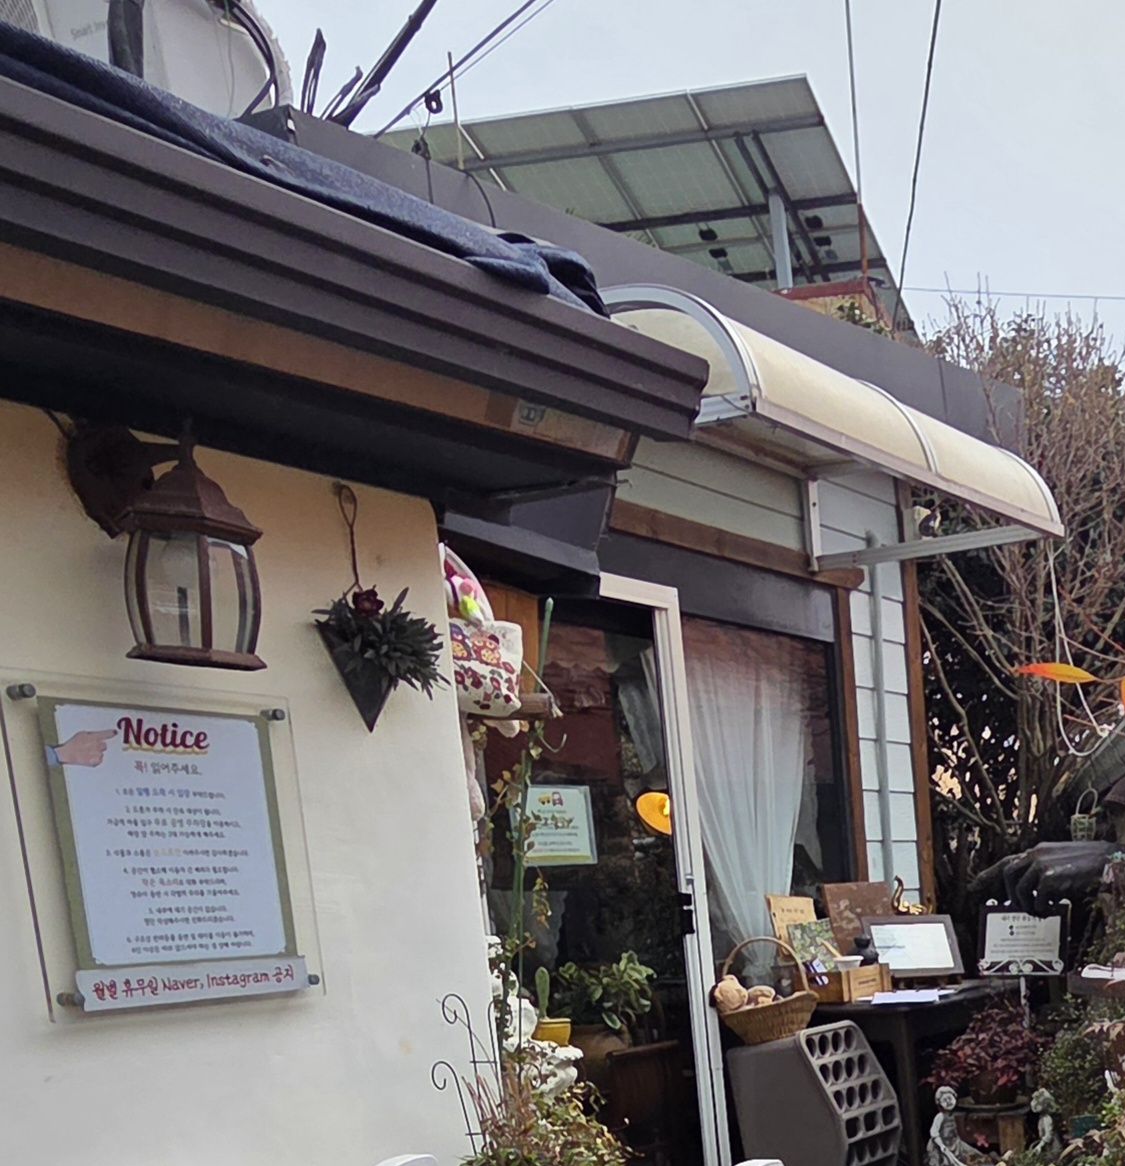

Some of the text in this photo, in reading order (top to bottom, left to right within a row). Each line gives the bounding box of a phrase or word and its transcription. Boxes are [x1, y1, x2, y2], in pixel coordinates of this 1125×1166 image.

[117, 717, 210, 750] Notice
[122, 977, 159, 998] 휴무일
[163, 977, 204, 993] Naver,
[206, 971, 270, 989] Instagram
[272, 965, 295, 984] 공지
